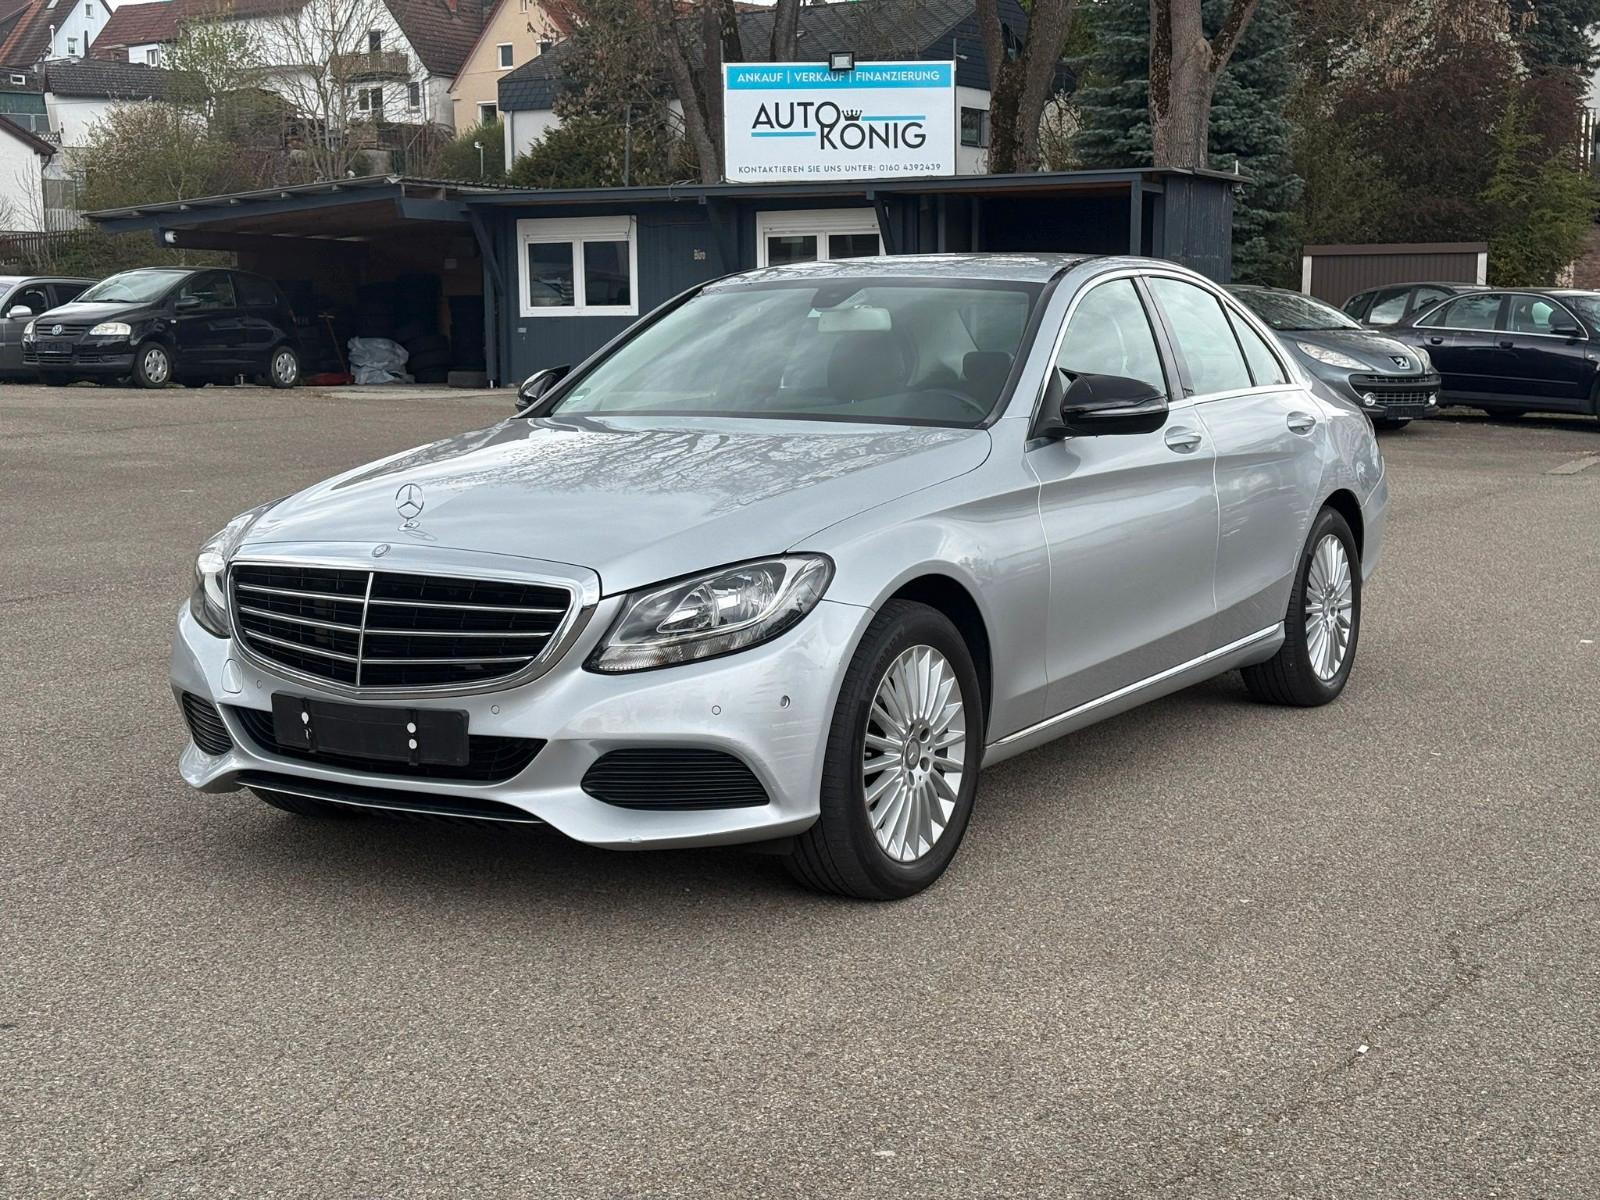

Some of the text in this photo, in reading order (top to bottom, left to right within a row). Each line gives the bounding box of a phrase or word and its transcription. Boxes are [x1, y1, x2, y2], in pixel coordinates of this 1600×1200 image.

[737, 70, 940, 83] ANKAUF VERKAUF FINANZIERUNG
[752, 101, 841, 130] AUTO
[738, 163, 941, 174] KONTAKTIEREN SIE UNS UNTER: 0160 4392439
